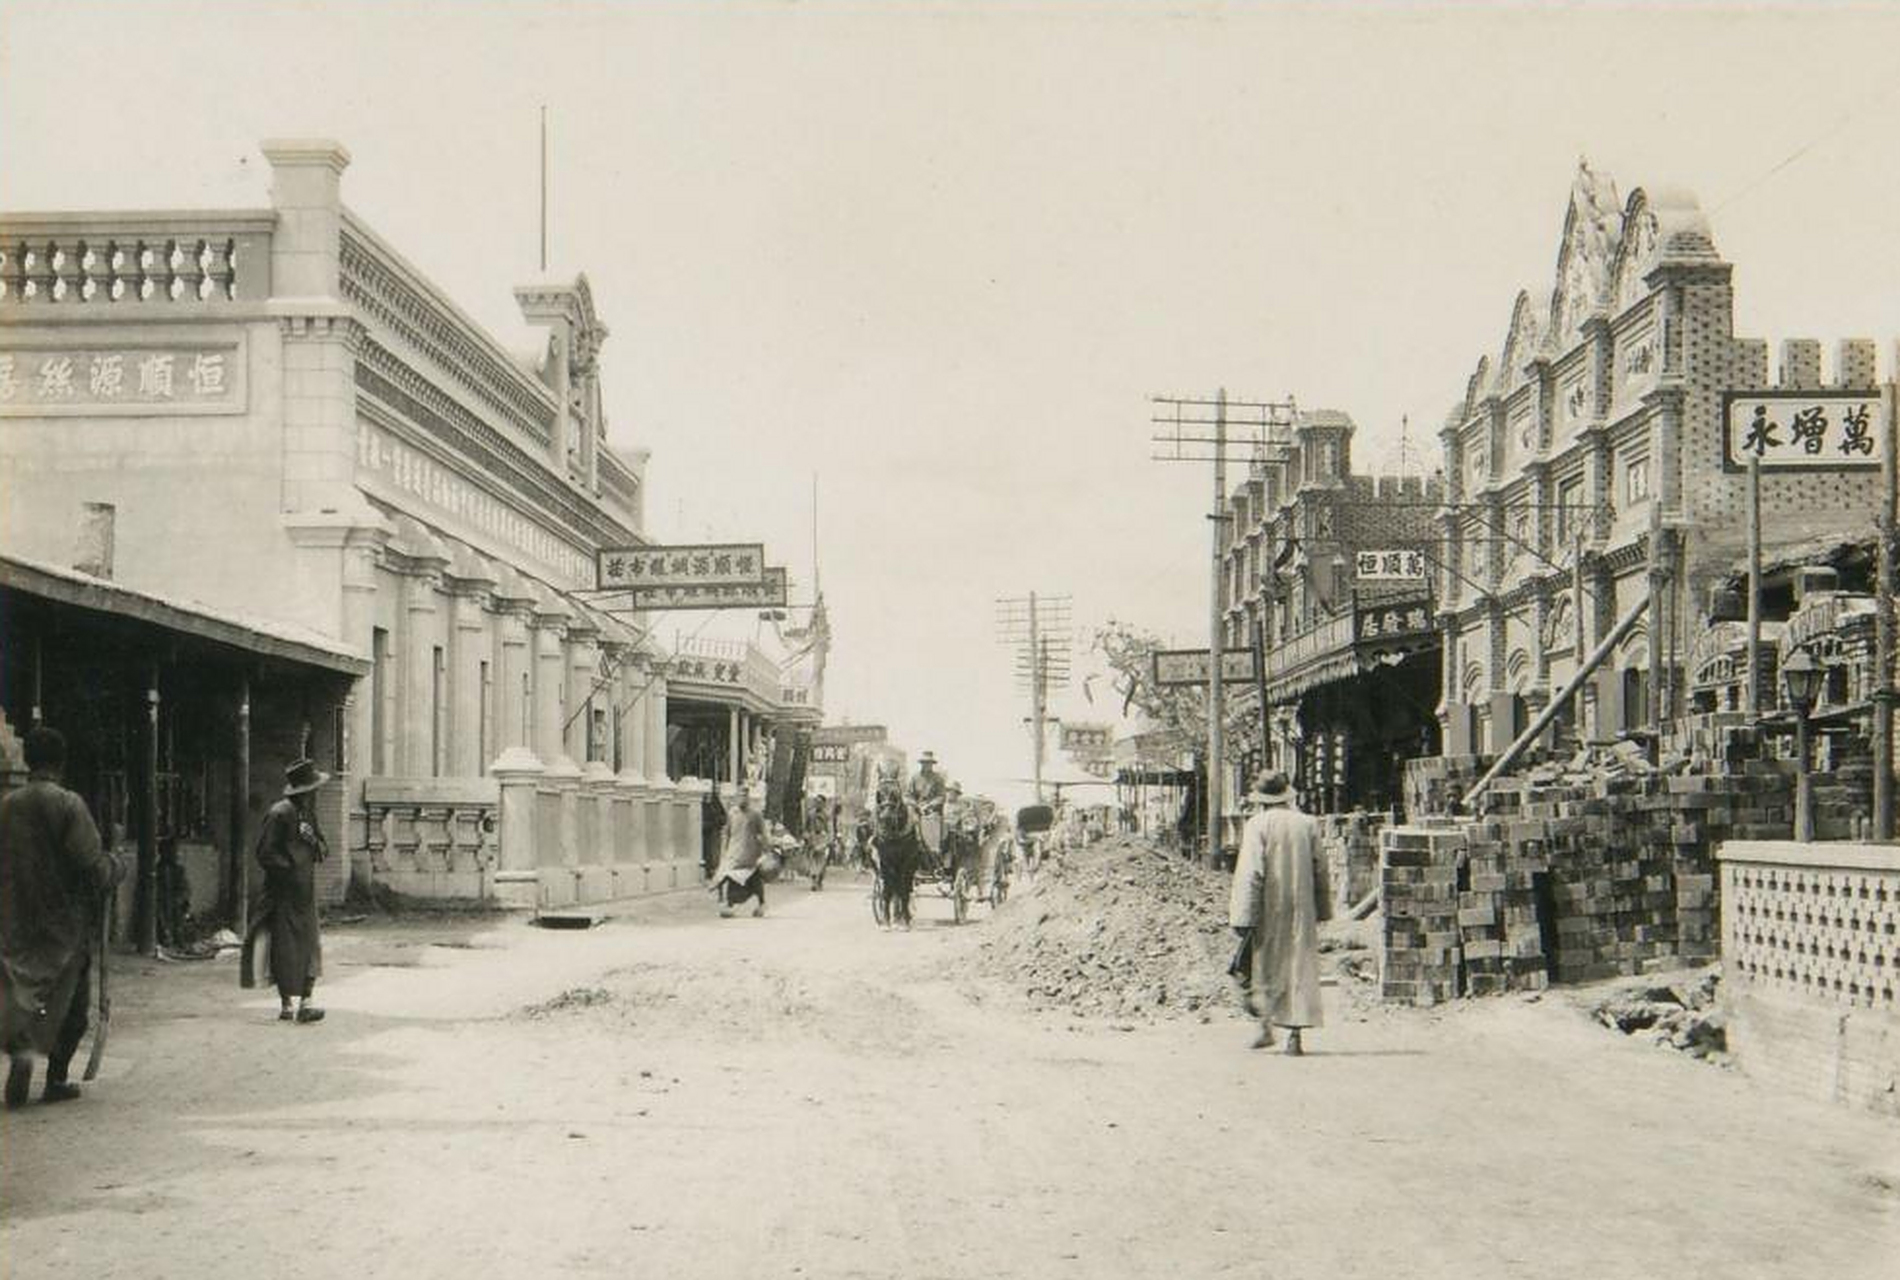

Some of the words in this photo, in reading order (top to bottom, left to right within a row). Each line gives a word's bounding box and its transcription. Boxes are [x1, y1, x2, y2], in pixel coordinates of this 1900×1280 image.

[1742, 405, 1876, 457] 萬增永
[1358, 552, 1424, 577] 萬順恒
